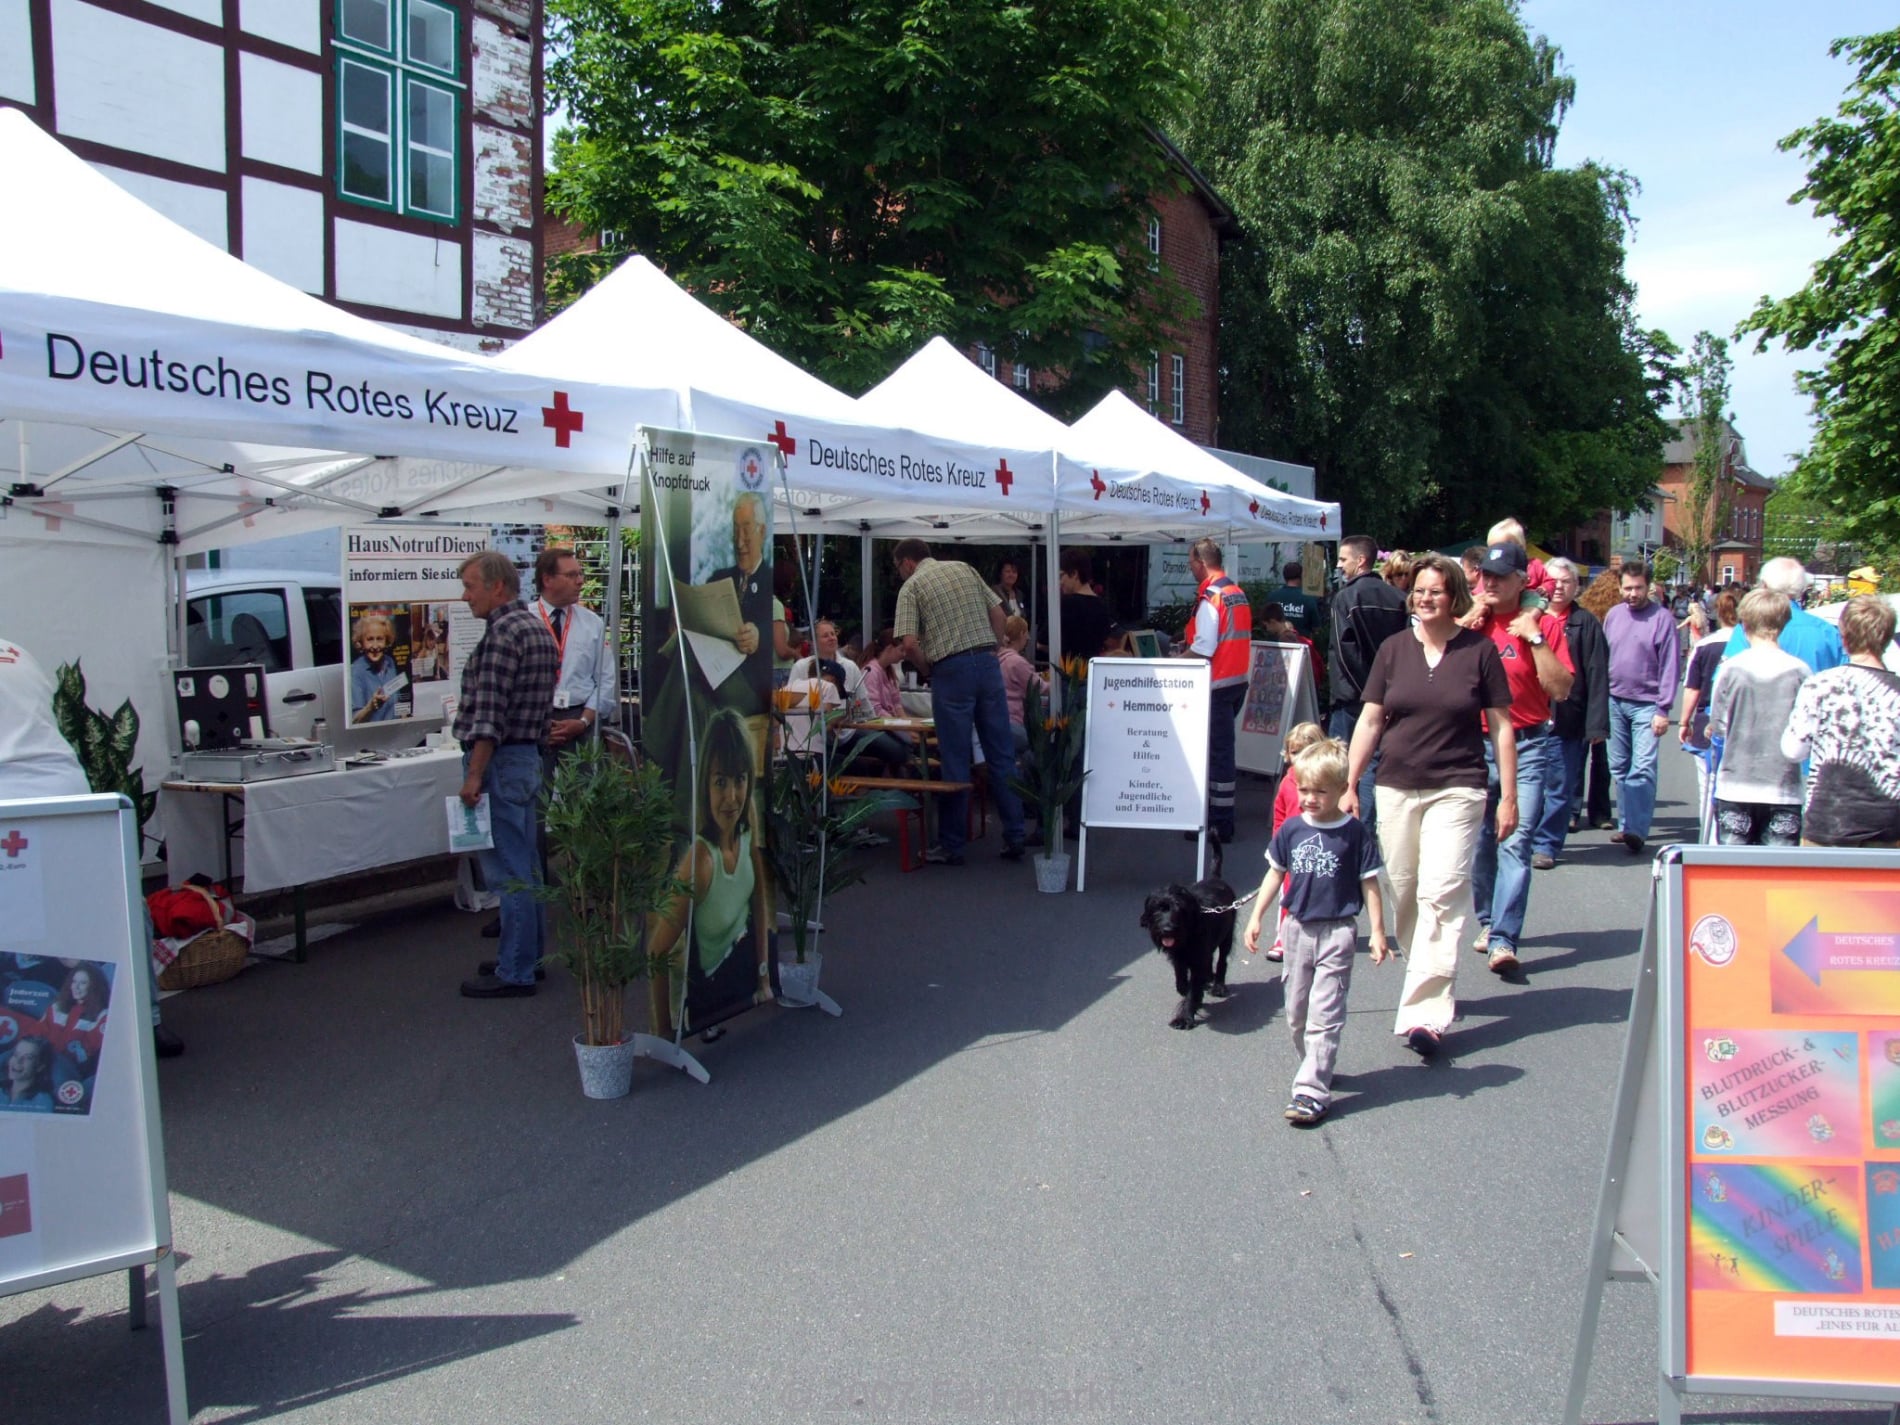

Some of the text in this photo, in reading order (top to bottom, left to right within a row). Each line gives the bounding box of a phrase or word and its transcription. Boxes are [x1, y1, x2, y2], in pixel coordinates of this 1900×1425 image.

[47, 333, 519, 434] Deutsches Rotes Kreuz
[650, 446, 696, 466] Hilfe auf
[809, 438, 986, 488] Deutsches Rotes Kreuz
[651, 471, 710, 492] Knopfdruck
[1110, 480, 1197, 511] Deutsches Rotes Kreuz
[421, 567, 441, 580] Sie
[1104, 676, 1194, 691] Jugendhilfestation
[1123, 700, 1173, 712] Hemmoor
[1127, 727, 1168, 738] Beratung
[1142, 739, 1151, 748] &
[1133, 751, 1160, 760] Hilfen
[1119, 791, 1172, 802] Jugendliche
[1115, 803, 1174, 813] und Familien
[1835, 936, 1895, 946] DEUTSCHES
[1830, 955, 1864, 966] ROTES
[1700, 1037, 1817, 1101] BLUTDRUCK- &
[1717, 1060, 1827, 1118] BLUTZUCKER-
[1744, 1086, 1820, 1130] MESSUNG
[1774, 1207, 1840, 1260] SPIELE
[1793, 1306, 1900, 1319] DEUTSCHES ROTES
